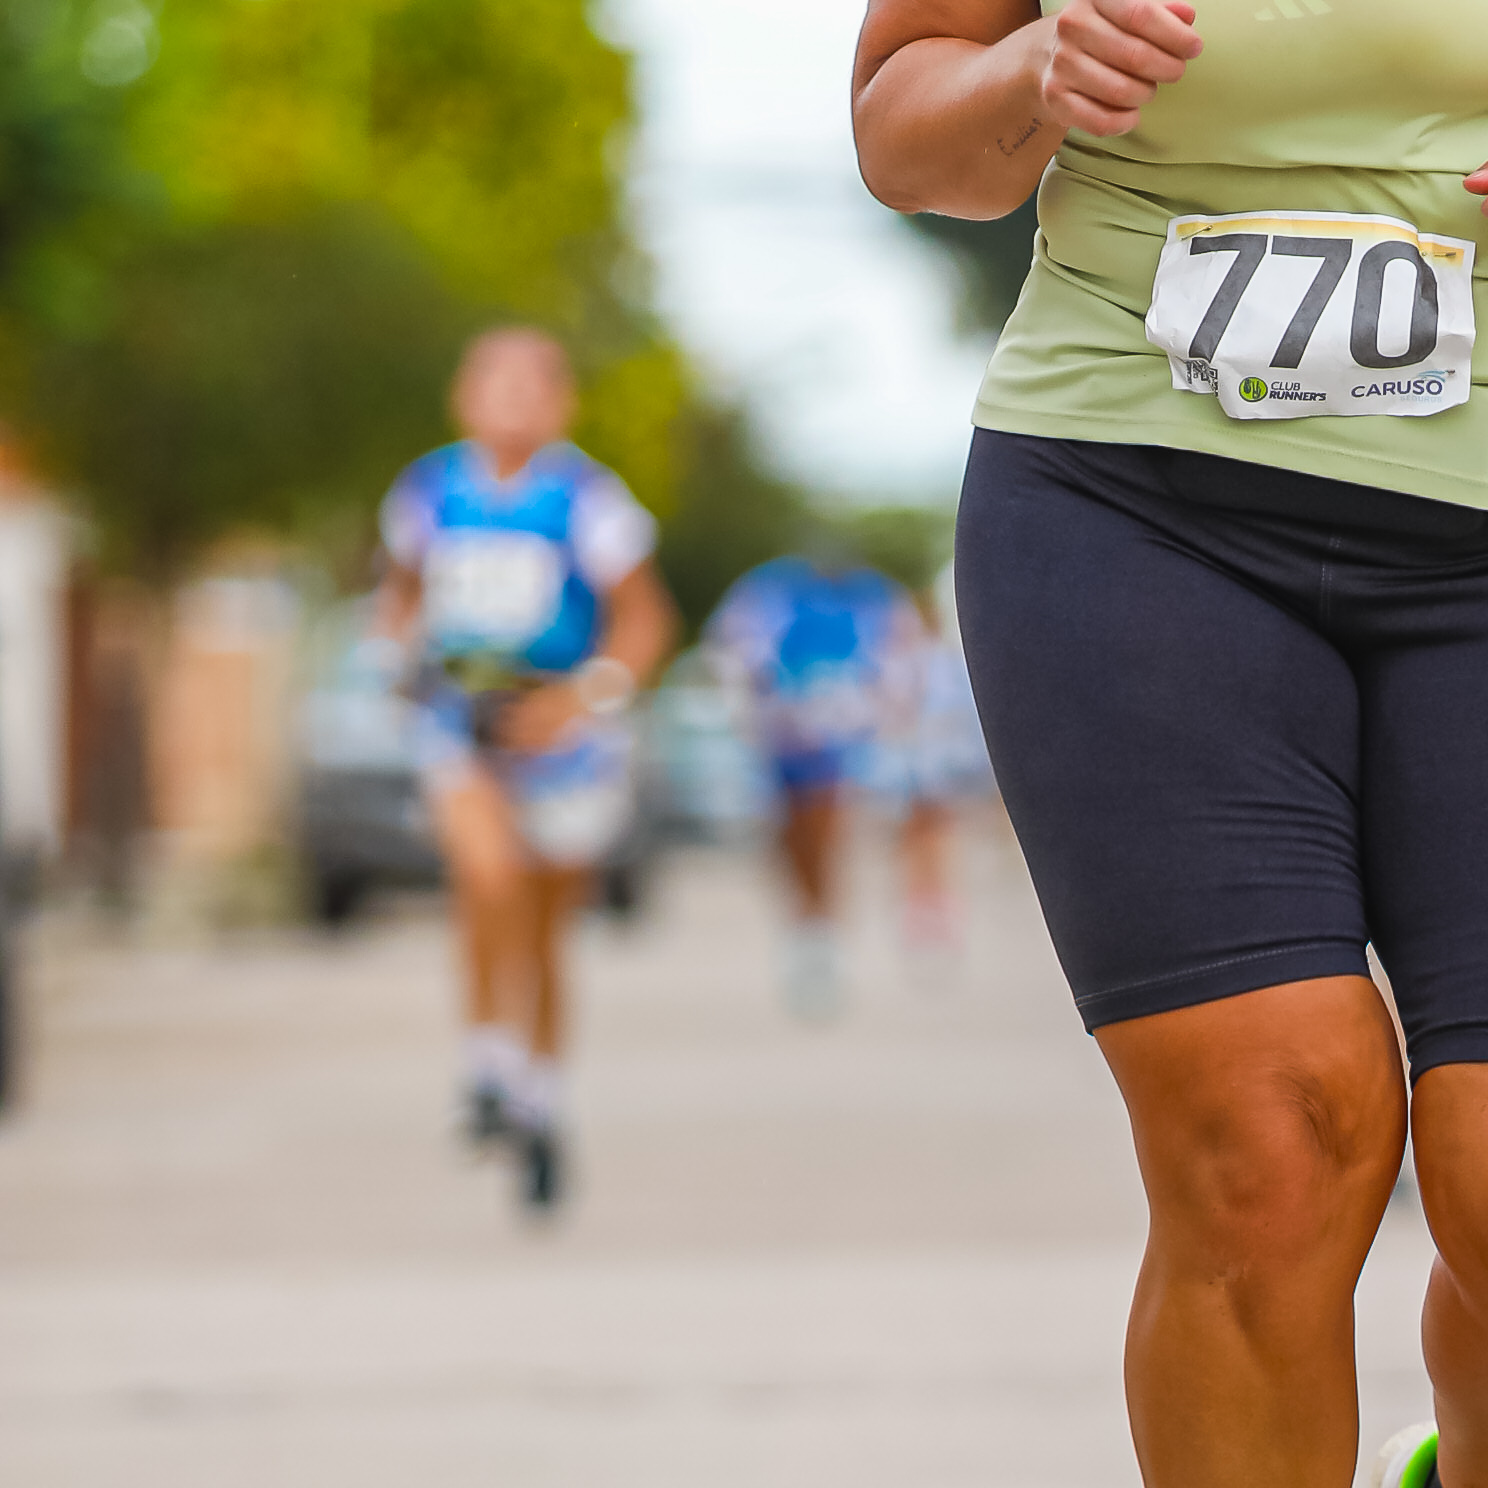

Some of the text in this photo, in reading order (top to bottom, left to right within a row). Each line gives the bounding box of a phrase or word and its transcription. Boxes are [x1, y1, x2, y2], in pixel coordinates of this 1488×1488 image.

[1188, 233, 1439, 369] 770
[1271, 381, 1301, 391] CLUB
[1351, 379, 1443, 398] CARUSO
[1269, 391, 1326, 401] RUNNER'S
